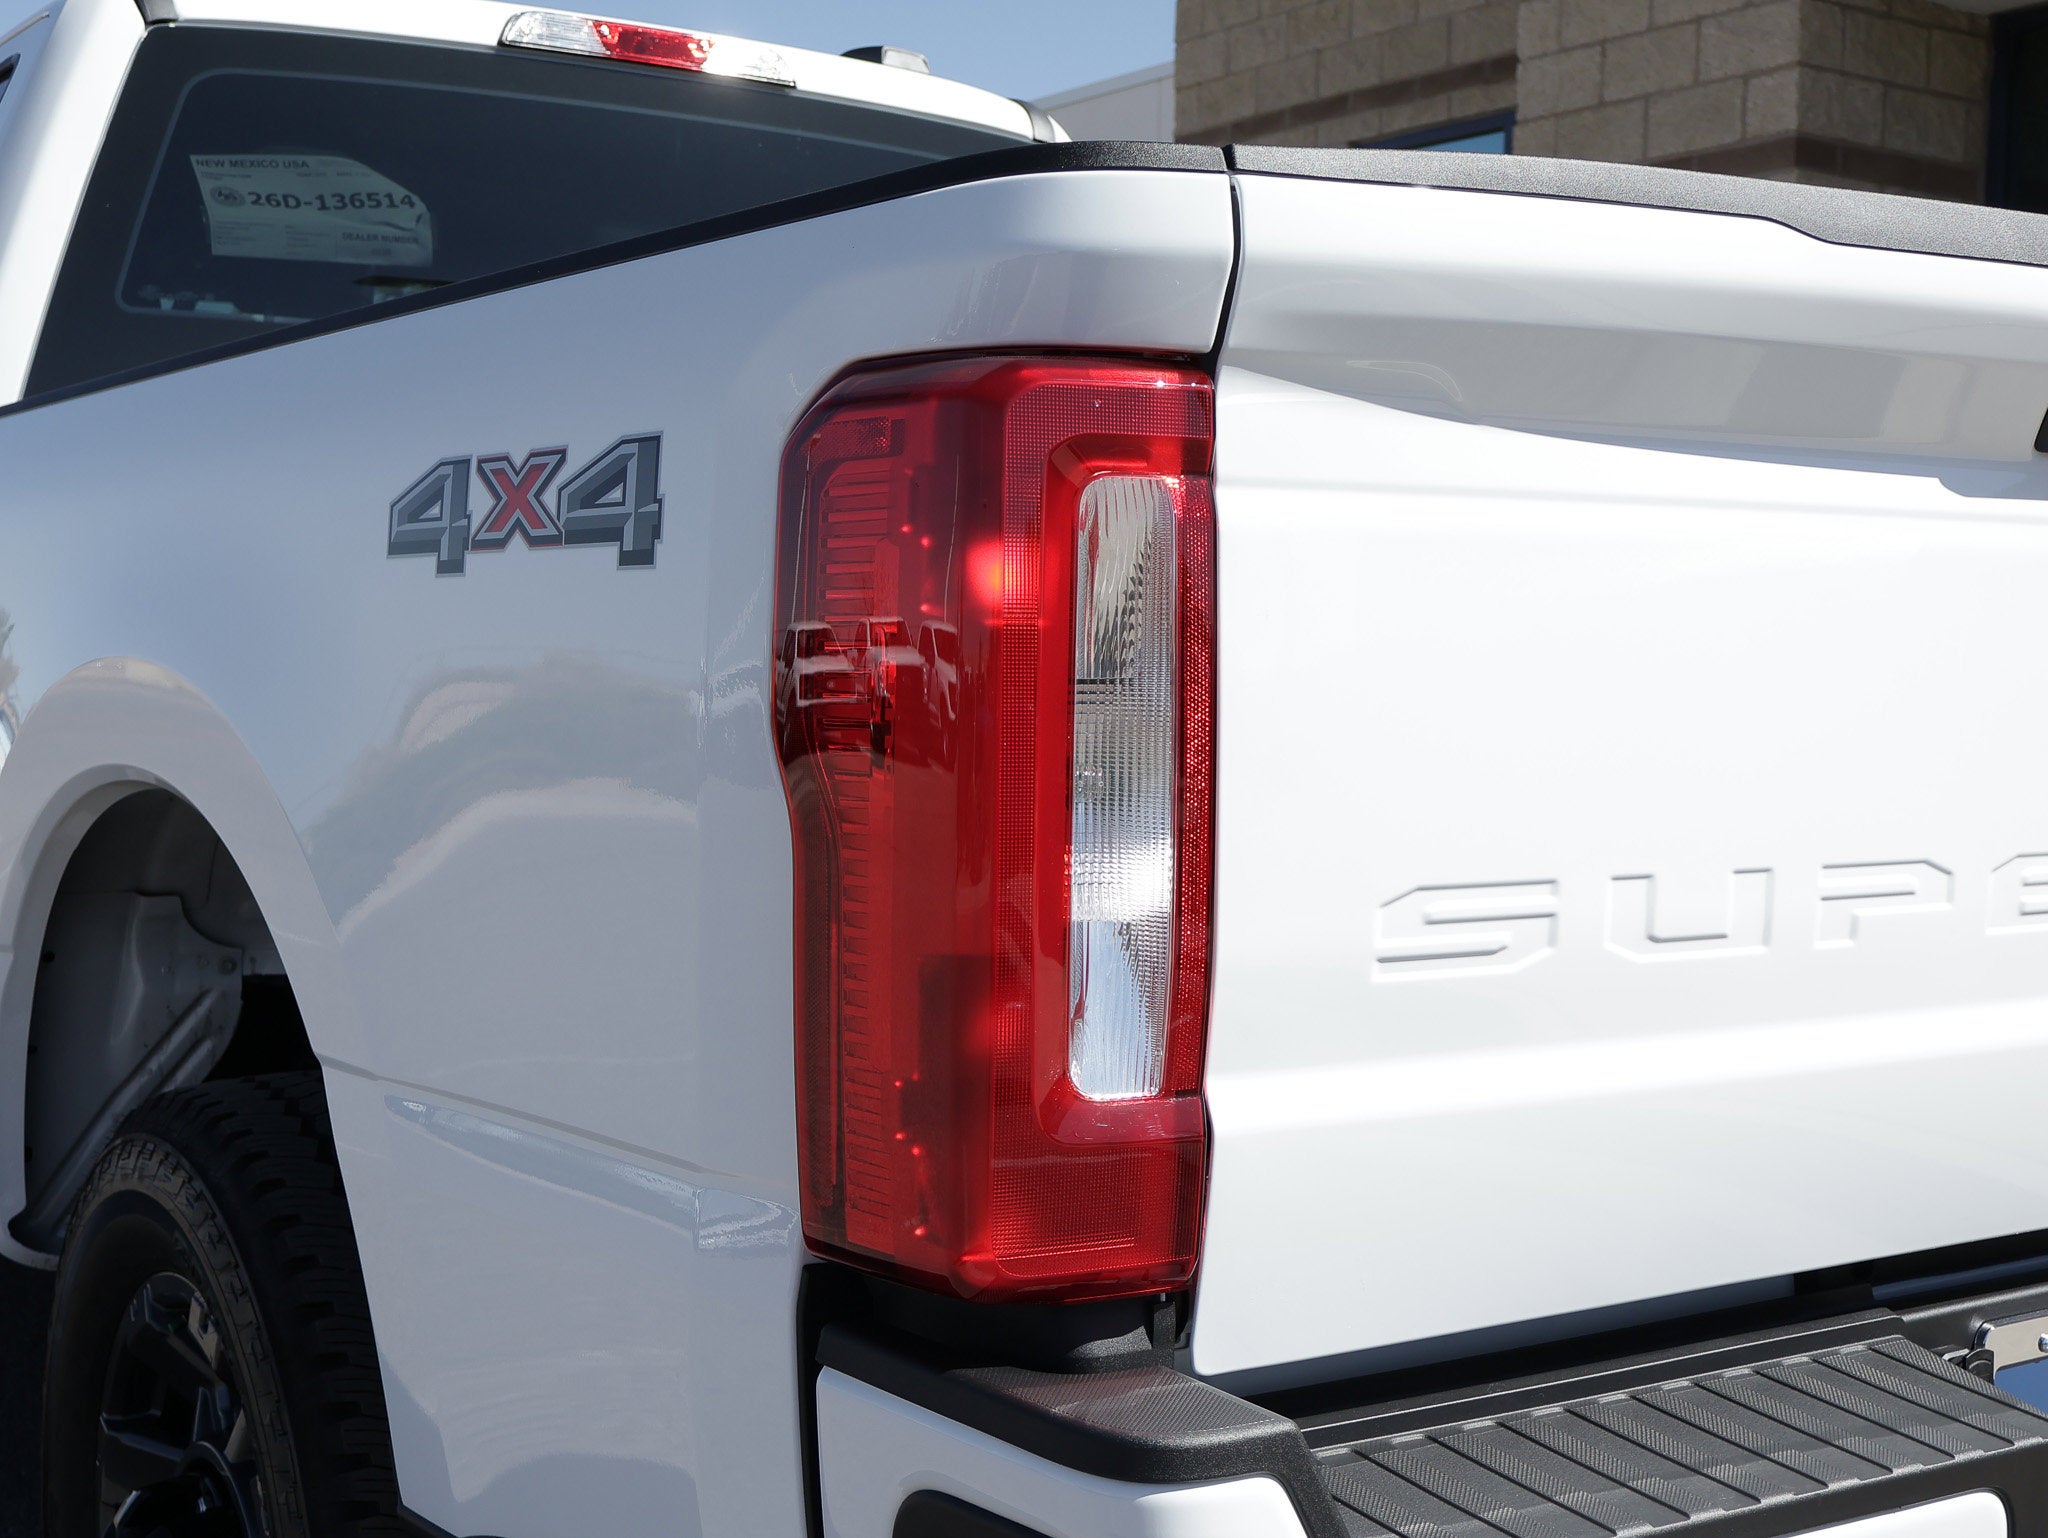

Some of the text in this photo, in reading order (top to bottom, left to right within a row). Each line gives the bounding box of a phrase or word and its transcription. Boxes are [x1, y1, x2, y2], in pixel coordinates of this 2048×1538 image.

[195, 158, 310, 170] NEW MEXICO USA
[247, 191, 416, 212] 26D-136514
[342, 231, 379, 243] DEALER
